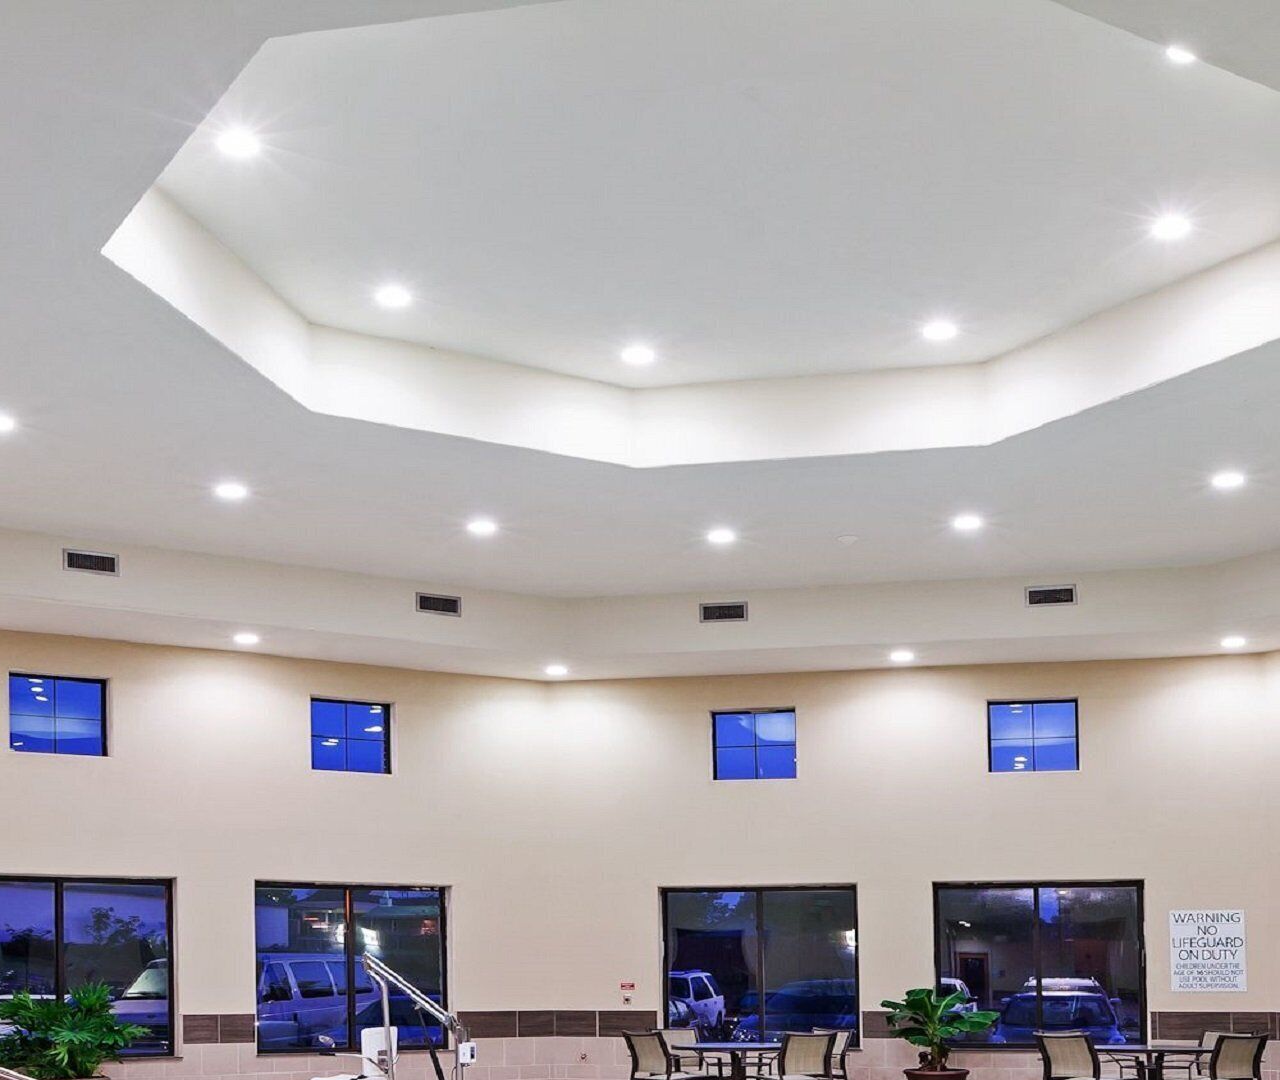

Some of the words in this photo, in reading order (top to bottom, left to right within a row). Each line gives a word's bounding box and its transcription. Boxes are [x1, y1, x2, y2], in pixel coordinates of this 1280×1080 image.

[1173, 913, 1241, 923] WARNING
[1197, 925, 1217, 935] NO
[1172, 937, 1244, 948] LIFEGUARD
[1178, 949, 1198, 960] ON
[1201, 949, 1238, 960] DUTY
